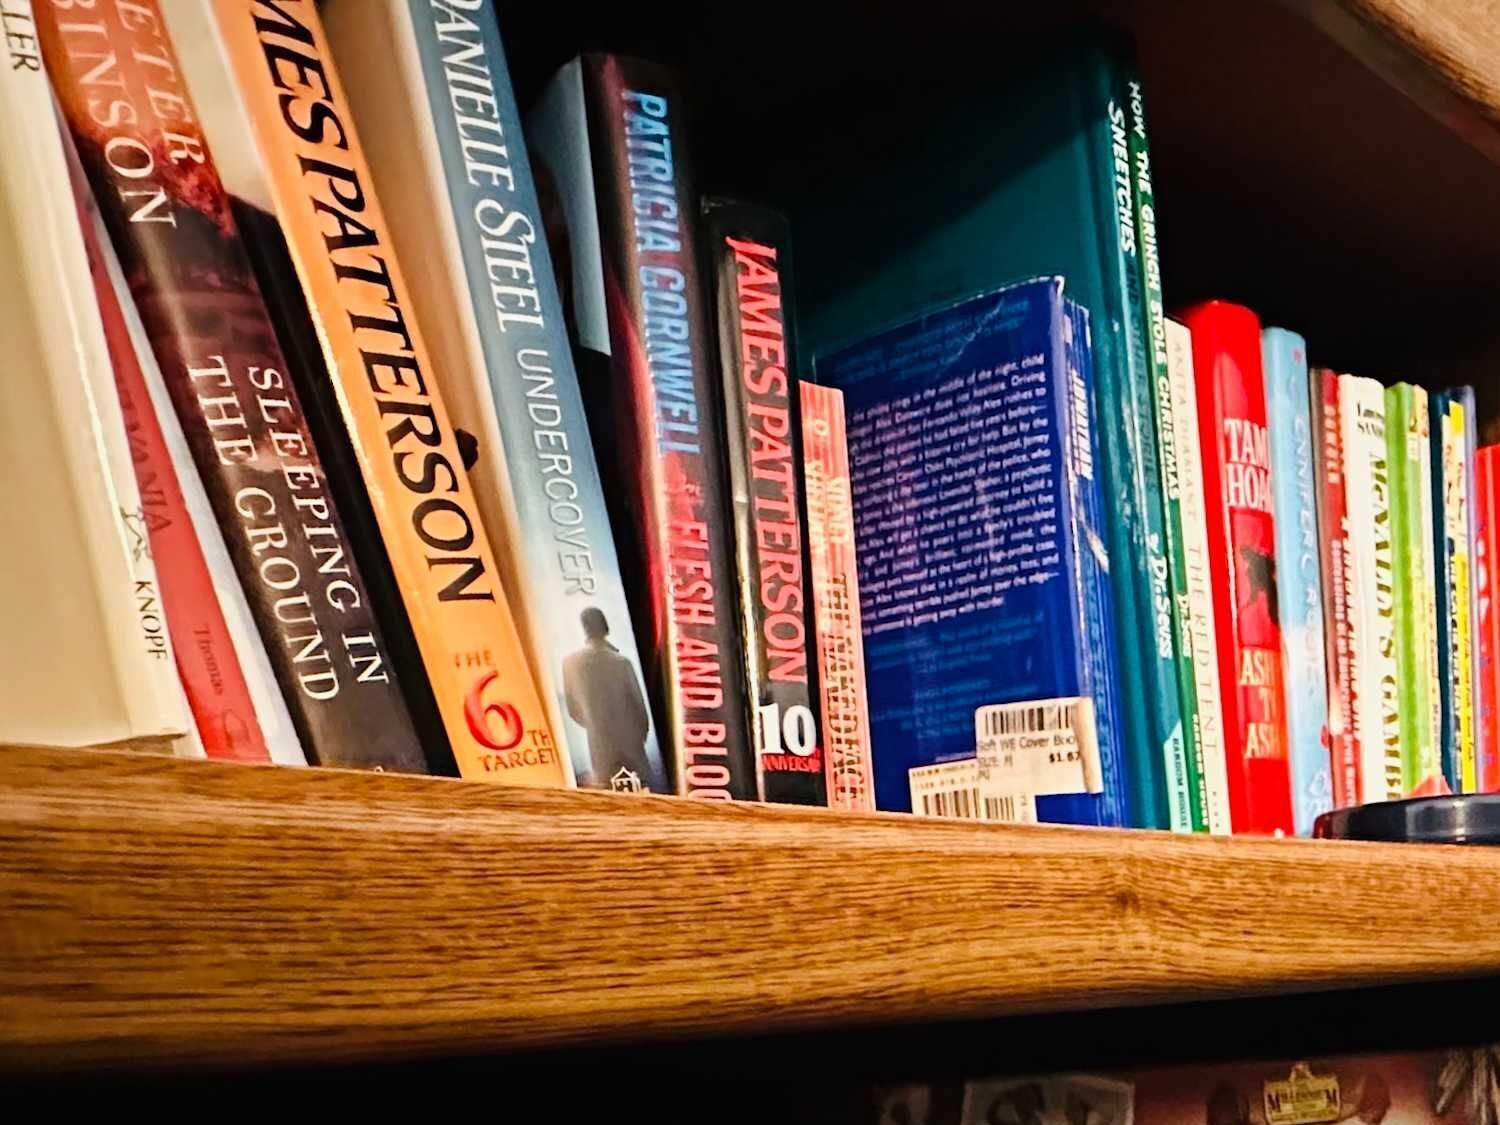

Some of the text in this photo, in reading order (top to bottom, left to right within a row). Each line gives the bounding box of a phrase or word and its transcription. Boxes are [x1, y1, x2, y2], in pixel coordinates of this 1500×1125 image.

[1107, 97, 1137, 258] SNEETCHES
[430, 0, 598, 598] DANIELLE STEEL UNDERCOVER
[622, 88, 700, 455] PATRICIA CORNWELL
[1128, 81, 1181, 501] HOW THE GRINCH STOLE CHRISTMAS
[298, 155, 497, 604] PATTERSON
[724, 234, 808, 685] JAMES PATTERSON
[187, 355, 260, 468] THE
[233, 486, 340, 701] GROUND
[248, 365, 391, 686] SLEEPING IN
[668, 521, 718, 632] FLESH
[134, 579, 169, 661] KNOPF
[453, 649, 495, 669] THE
[676, 634, 724, 709] AND
[462, 668, 524, 751] 6
[759, 704, 817, 755] 10
[1019, 735, 1050, 749] Cover
